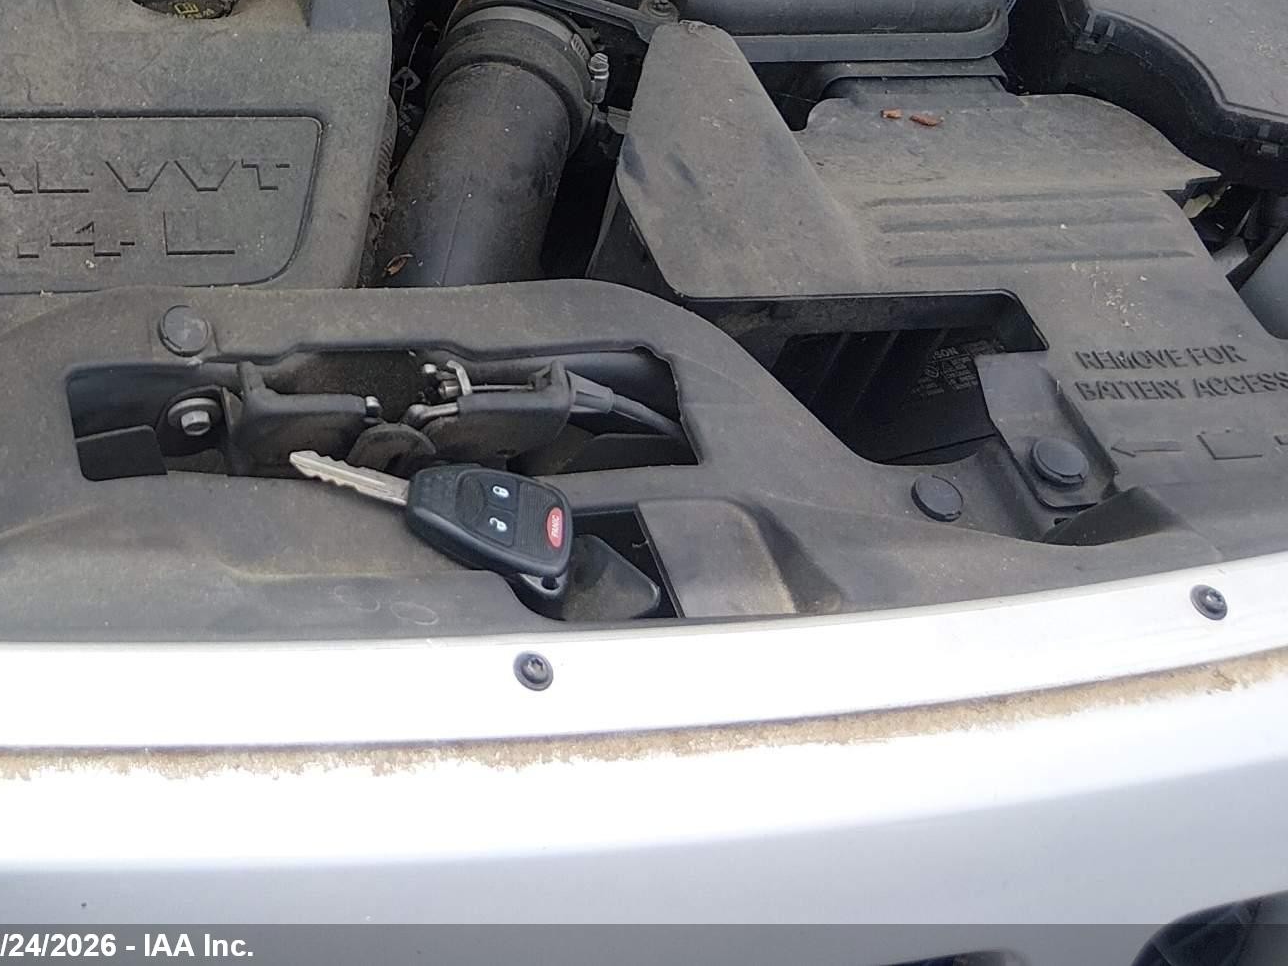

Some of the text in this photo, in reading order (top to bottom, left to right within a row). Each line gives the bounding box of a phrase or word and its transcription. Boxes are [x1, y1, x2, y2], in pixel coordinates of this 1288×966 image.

[106, 156, 292, 193] VVT
[1075, 344, 1248, 370] REMOVE FOR
[1074, 371, 1288, 401] BATTERY ACCESS
